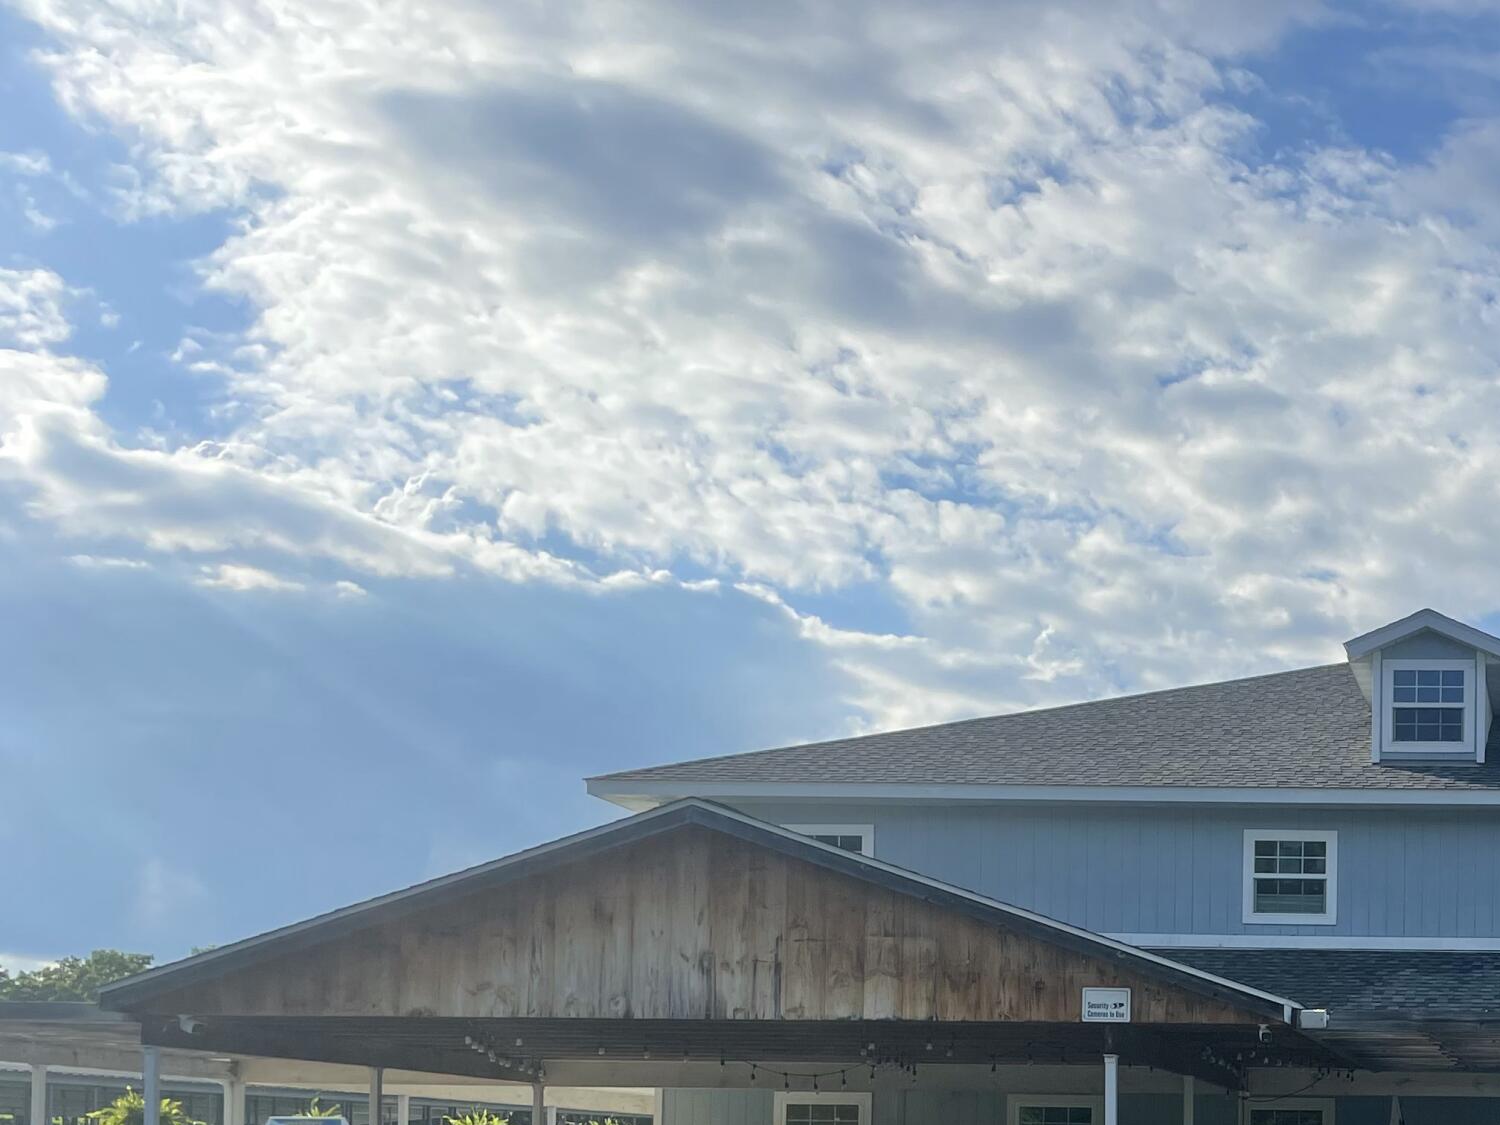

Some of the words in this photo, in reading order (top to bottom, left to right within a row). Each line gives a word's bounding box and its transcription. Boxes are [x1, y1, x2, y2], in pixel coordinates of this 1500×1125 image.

[1087, 1001, 1109, 1010] Security
[1087, 1010, 1109, 1018] Cameras
[1116, 1010, 1125, 1018] Use
